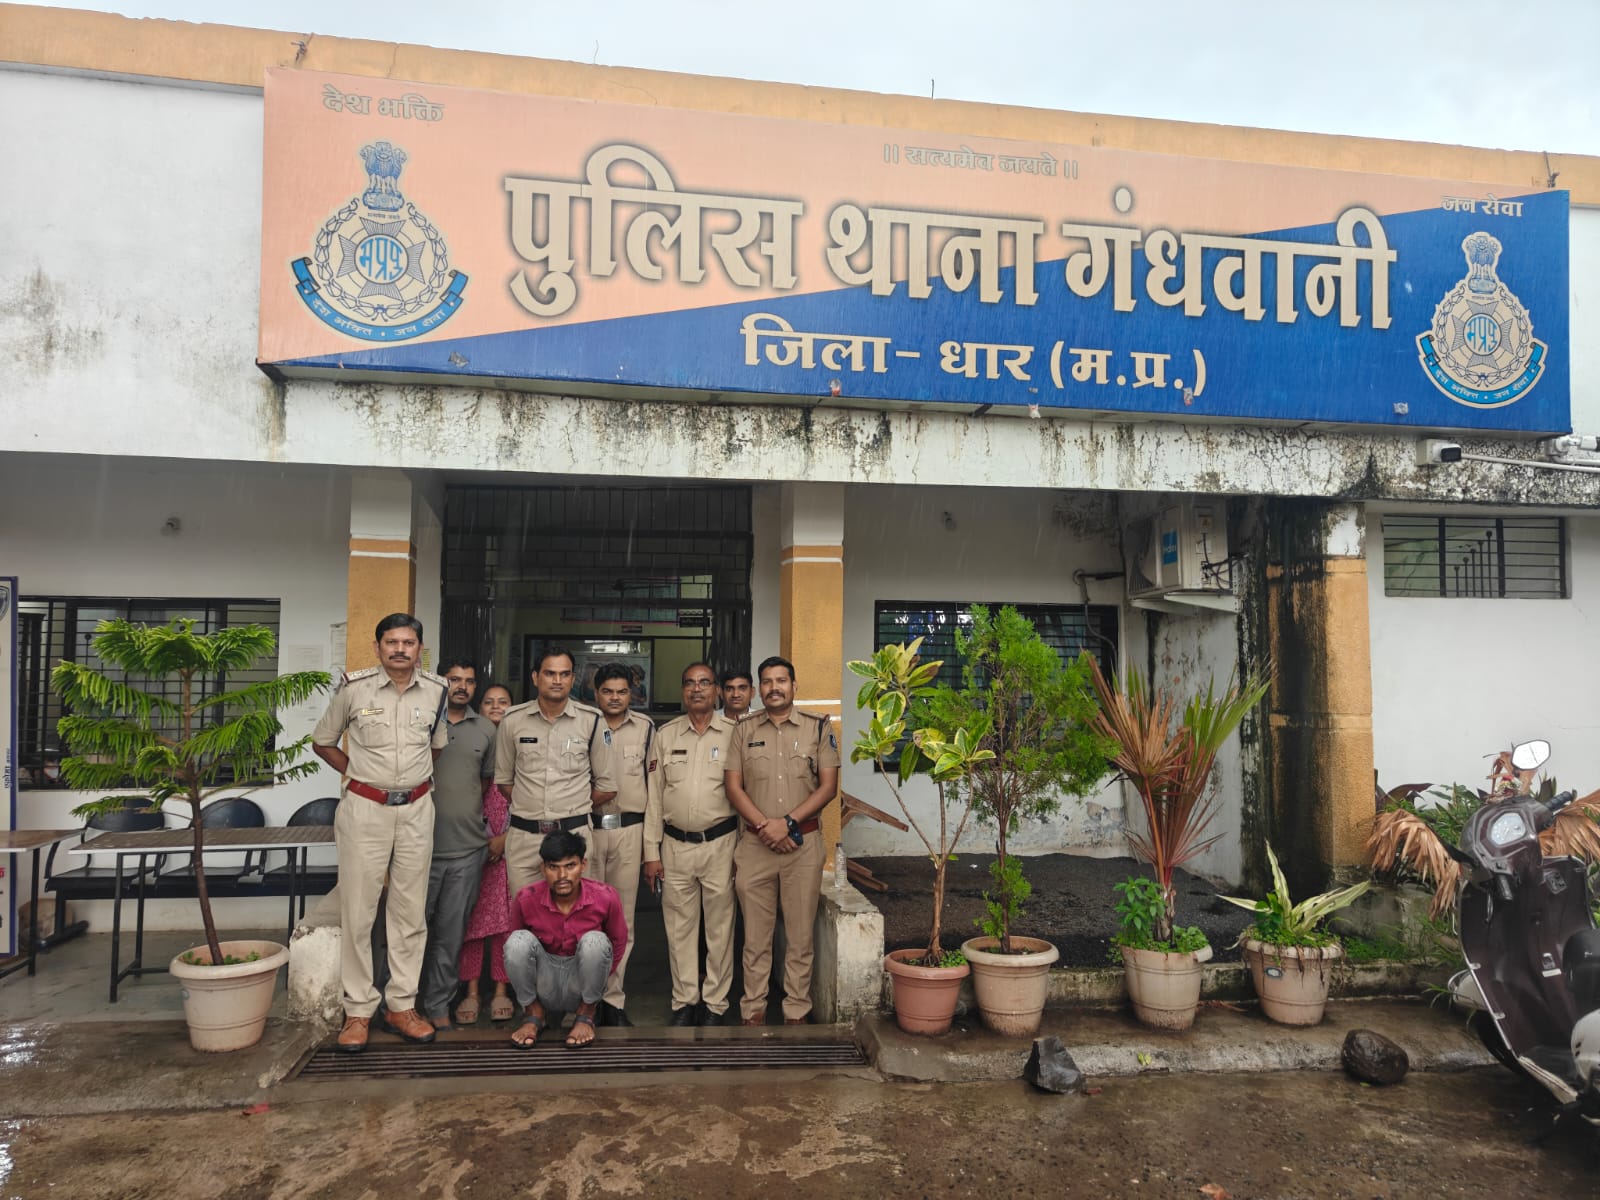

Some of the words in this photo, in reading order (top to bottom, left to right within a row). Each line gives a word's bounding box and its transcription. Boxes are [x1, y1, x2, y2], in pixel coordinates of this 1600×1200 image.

[322, 83, 373, 115] देश
[377, 93, 445, 121] भक्ति
[904, 144, 994, 171] सत्यमेव
[998, 152, 1058, 177] जयते
[1440, 195, 1477, 213] जन
[1481, 192, 1524, 217] सेवा
[504, 143, 804, 317] पुलिस
[826, 203, 1044, 306] थाना
[1062, 187, 1398, 330] गंधवानी
[939, 340, 1035, 381] धार
